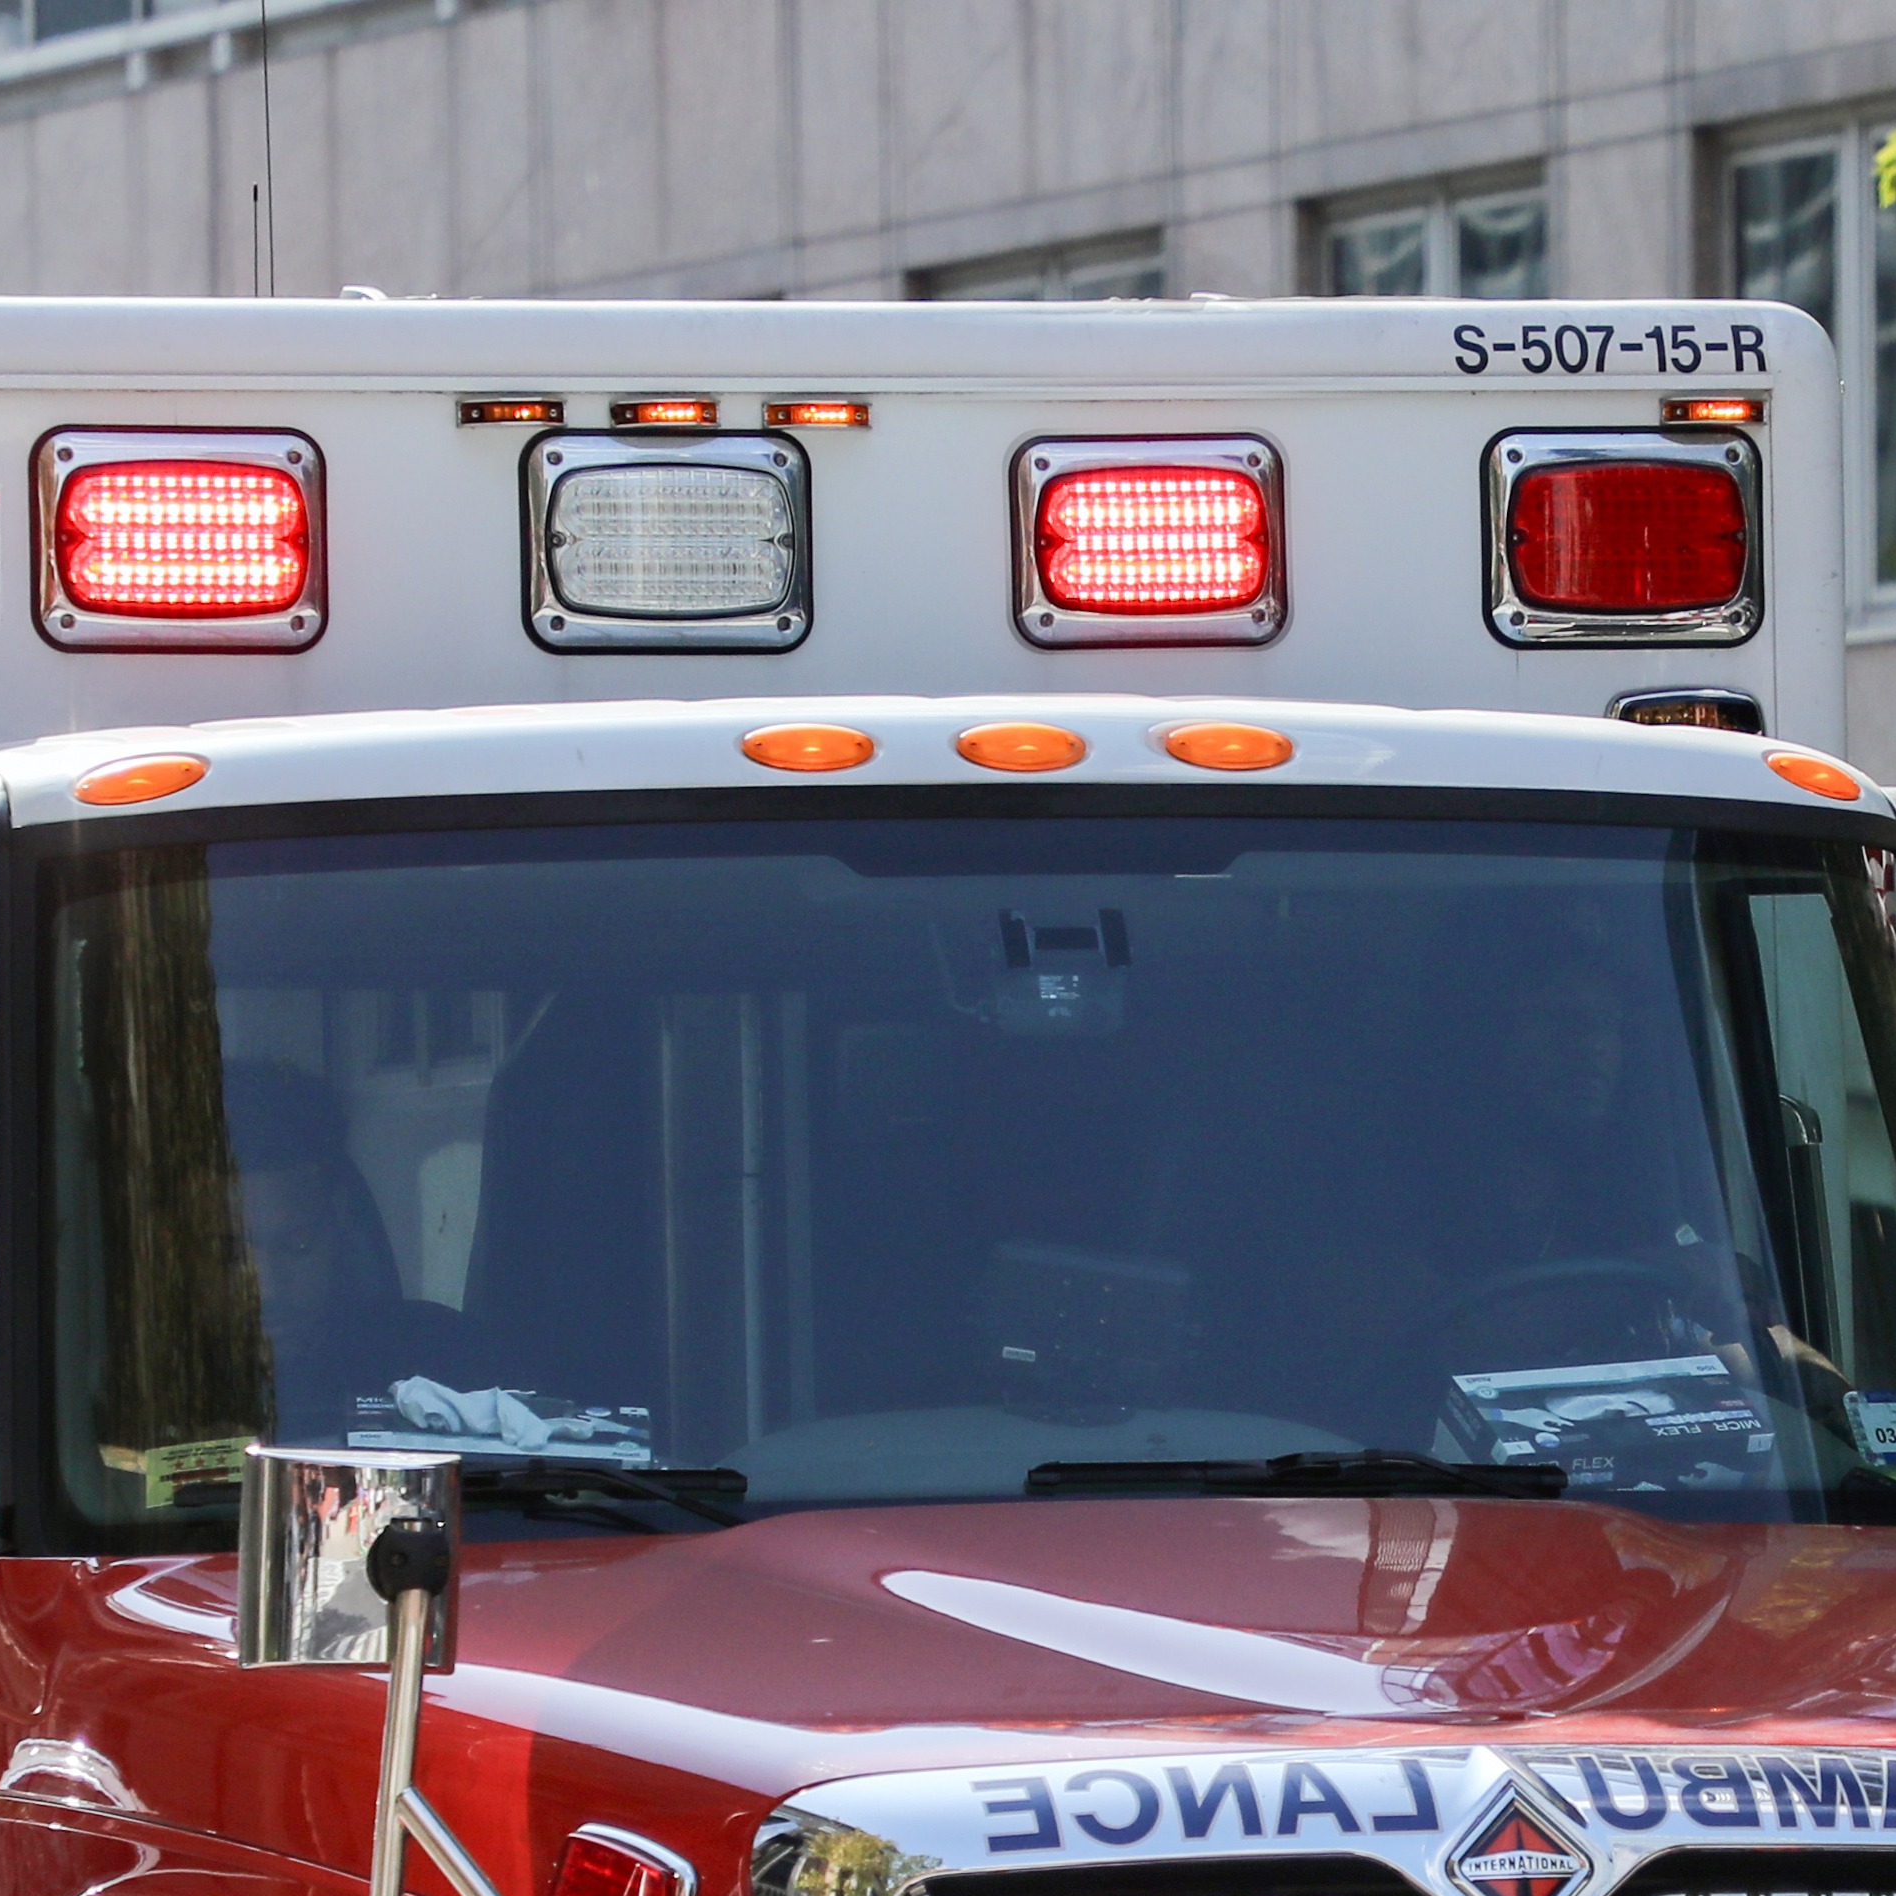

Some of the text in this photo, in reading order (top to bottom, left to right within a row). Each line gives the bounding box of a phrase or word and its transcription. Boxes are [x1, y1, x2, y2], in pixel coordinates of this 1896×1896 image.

[1453, 324, 1767, 375] S-507-15-R
[1652, 1424, 1702, 1437] FLEX
[1572, 1456, 1615, 1470] FLEX
[1468, 1856, 1574, 1873] INTERNATIONAL
